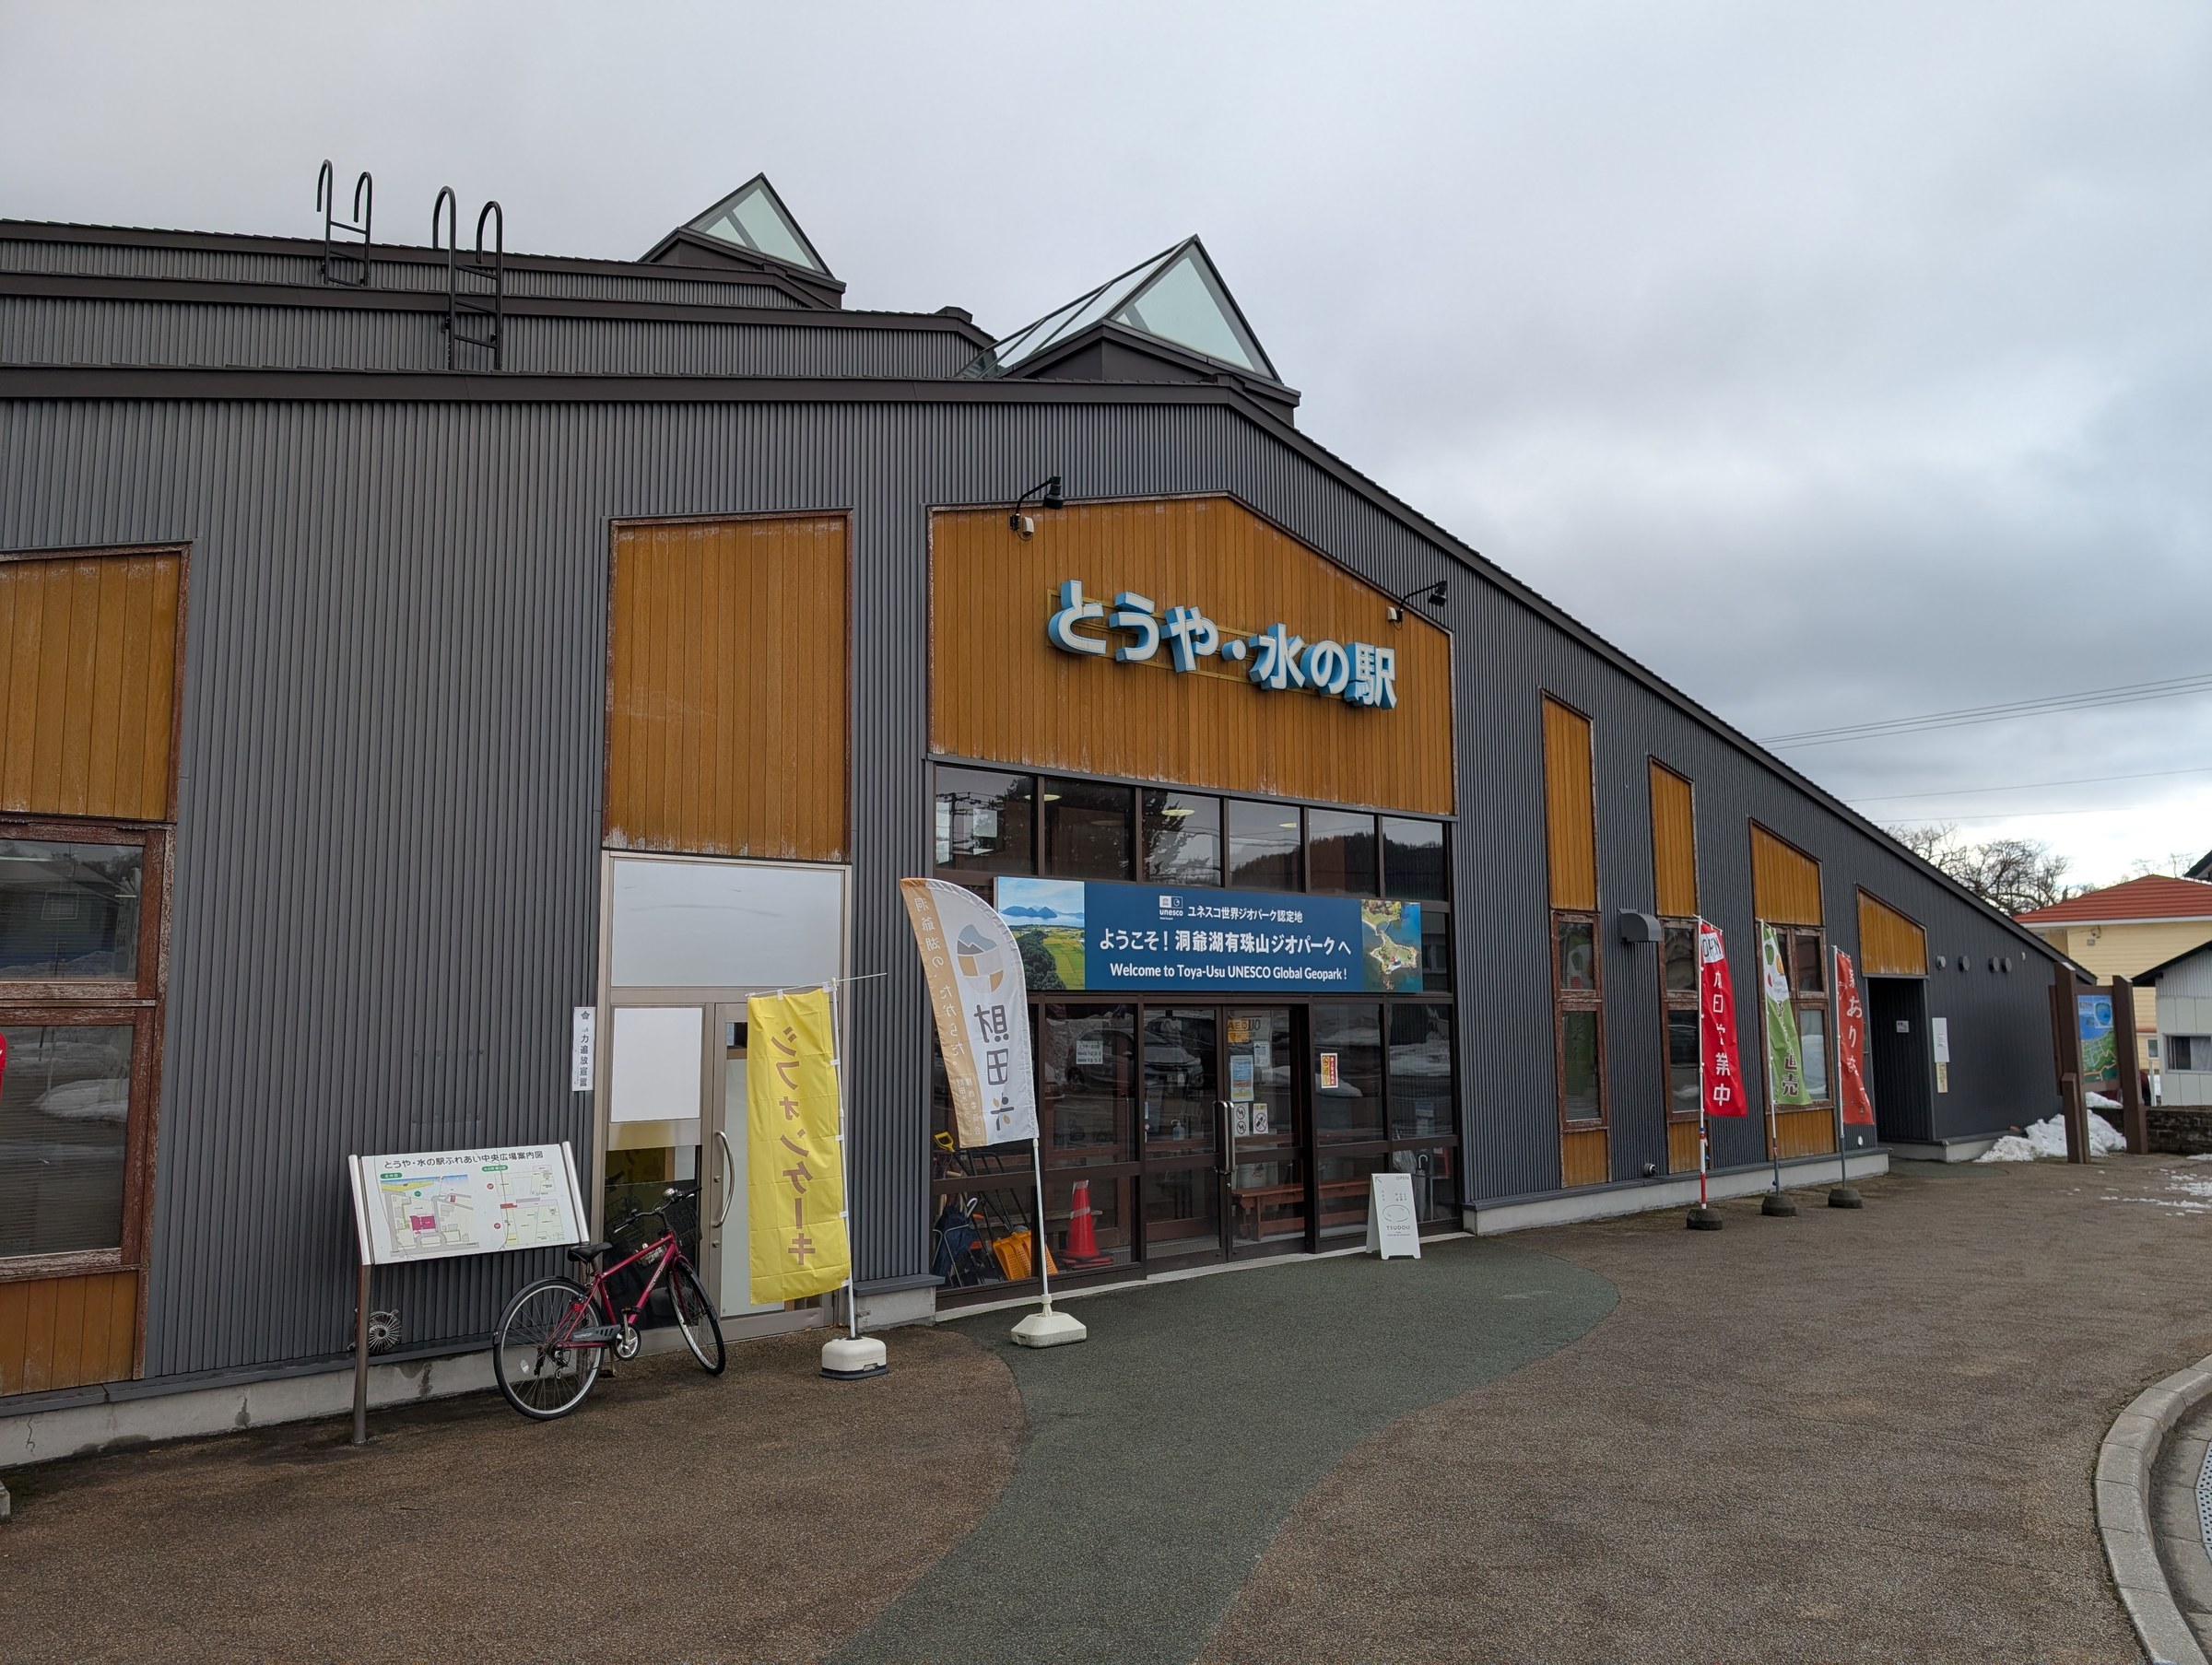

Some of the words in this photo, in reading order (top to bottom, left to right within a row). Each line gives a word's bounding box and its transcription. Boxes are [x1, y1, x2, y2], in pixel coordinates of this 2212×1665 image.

[1048, 579, 1397, 709] とうや・水の駅
[1187, 906, 1303, 923] ユネスコ世界ジオパーク認定地
[1110, 963, 1161, 977] Welcome
[1163, 965, 1175, 977] to
[1177, 964, 1225, 979] Toya-Usu
[1228, 966, 1271, 979] UNESCO
[1273, 967, 1302, 979] Global
[1228, 1021, 1247, 1030] AED
[579, 1026, 589, 1087] 力追放宣言
[384, 1150, 544, 1169] とうや・水の駅ふれあい中央広場案内図
